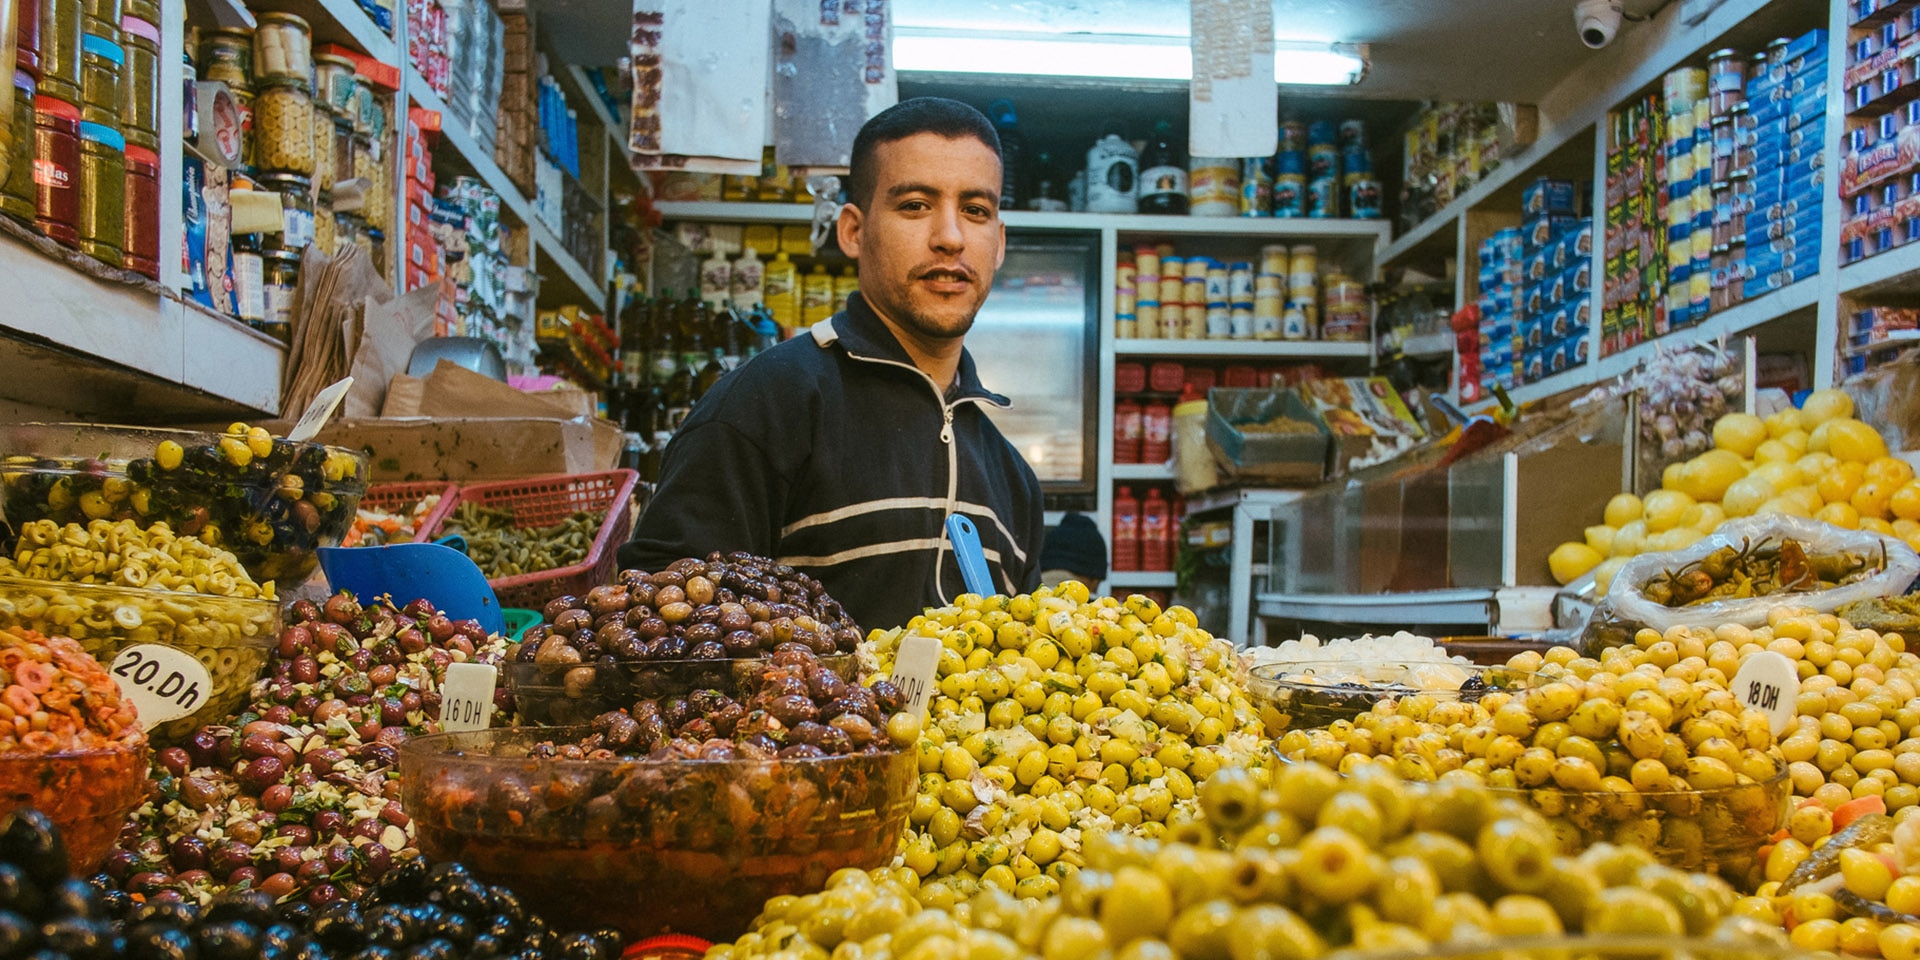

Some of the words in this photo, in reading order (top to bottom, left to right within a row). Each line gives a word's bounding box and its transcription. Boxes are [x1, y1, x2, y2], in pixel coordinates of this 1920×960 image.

[113, 651, 199, 709] 20.Dh
[905, 677, 924, 707] DH
[1747, 680, 1761, 706] 18
[1761, 684, 1780, 711] DH
[445, 698, 460, 722] 16
[464, 699, 483, 725] DH
